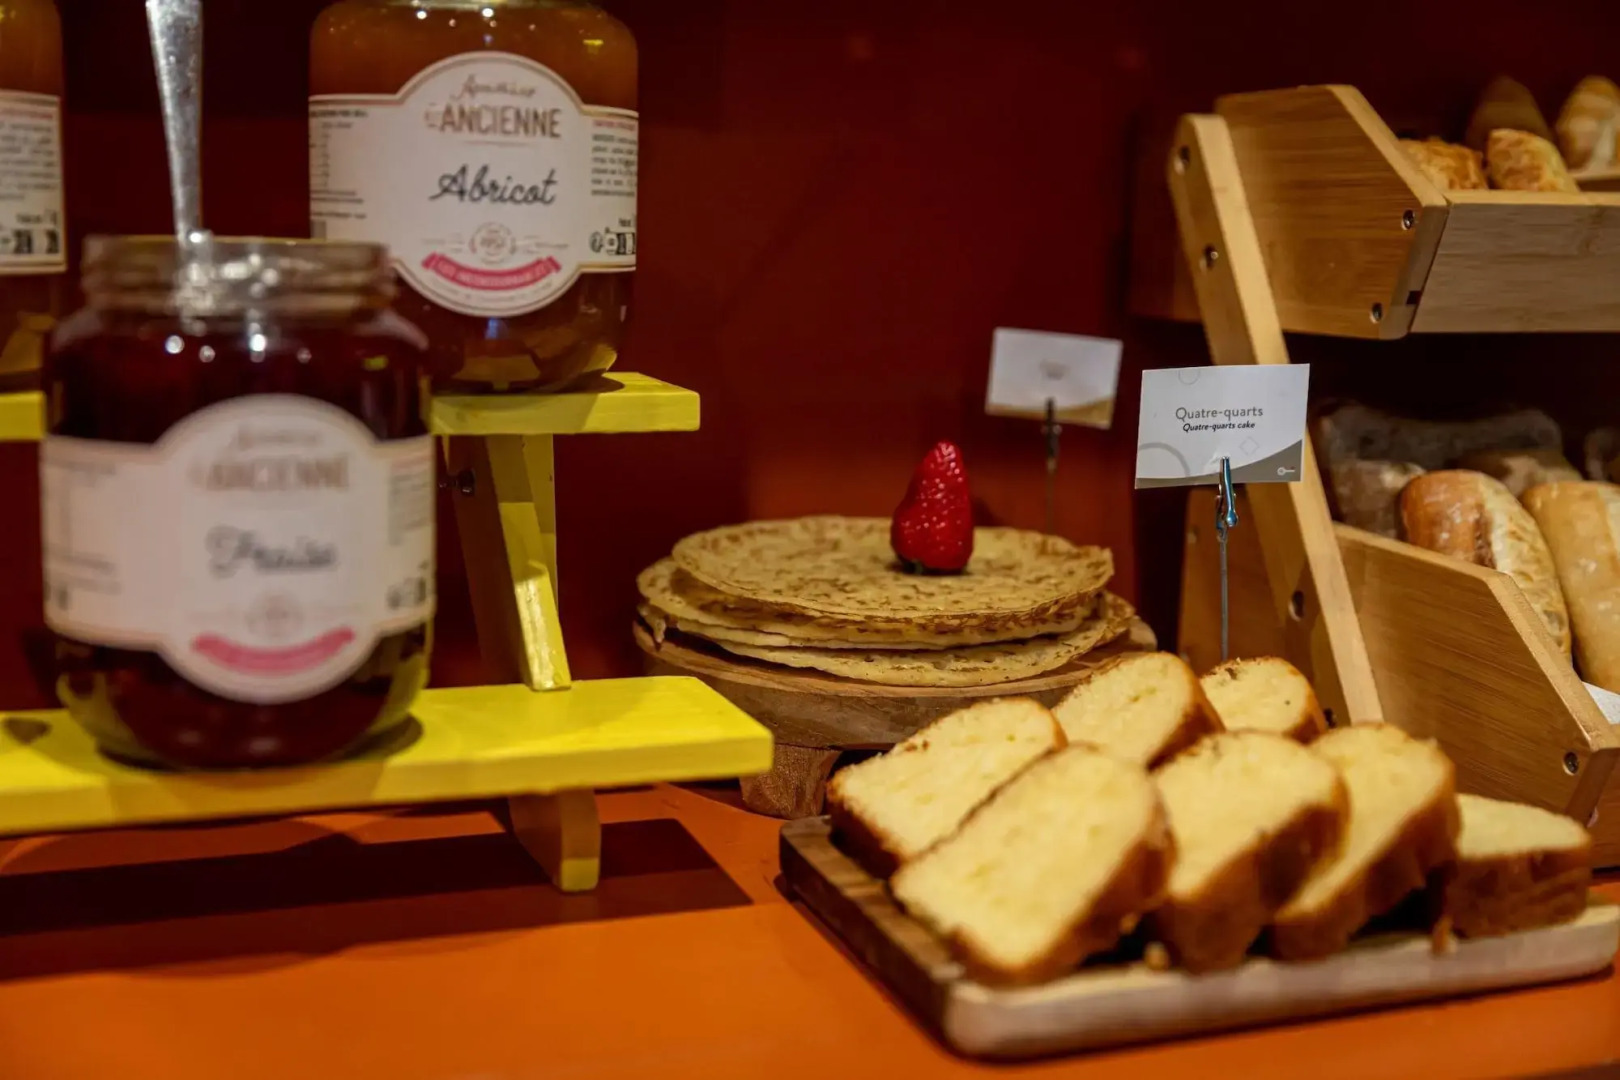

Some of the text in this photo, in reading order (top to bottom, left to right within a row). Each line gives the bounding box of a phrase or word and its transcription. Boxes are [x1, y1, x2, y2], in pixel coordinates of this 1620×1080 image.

[428, 163, 558, 206] Abricot
[1175, 406, 1264, 421] Quatre-quarts
[1182, 420, 1256, 433] Quatre-quarts cake
